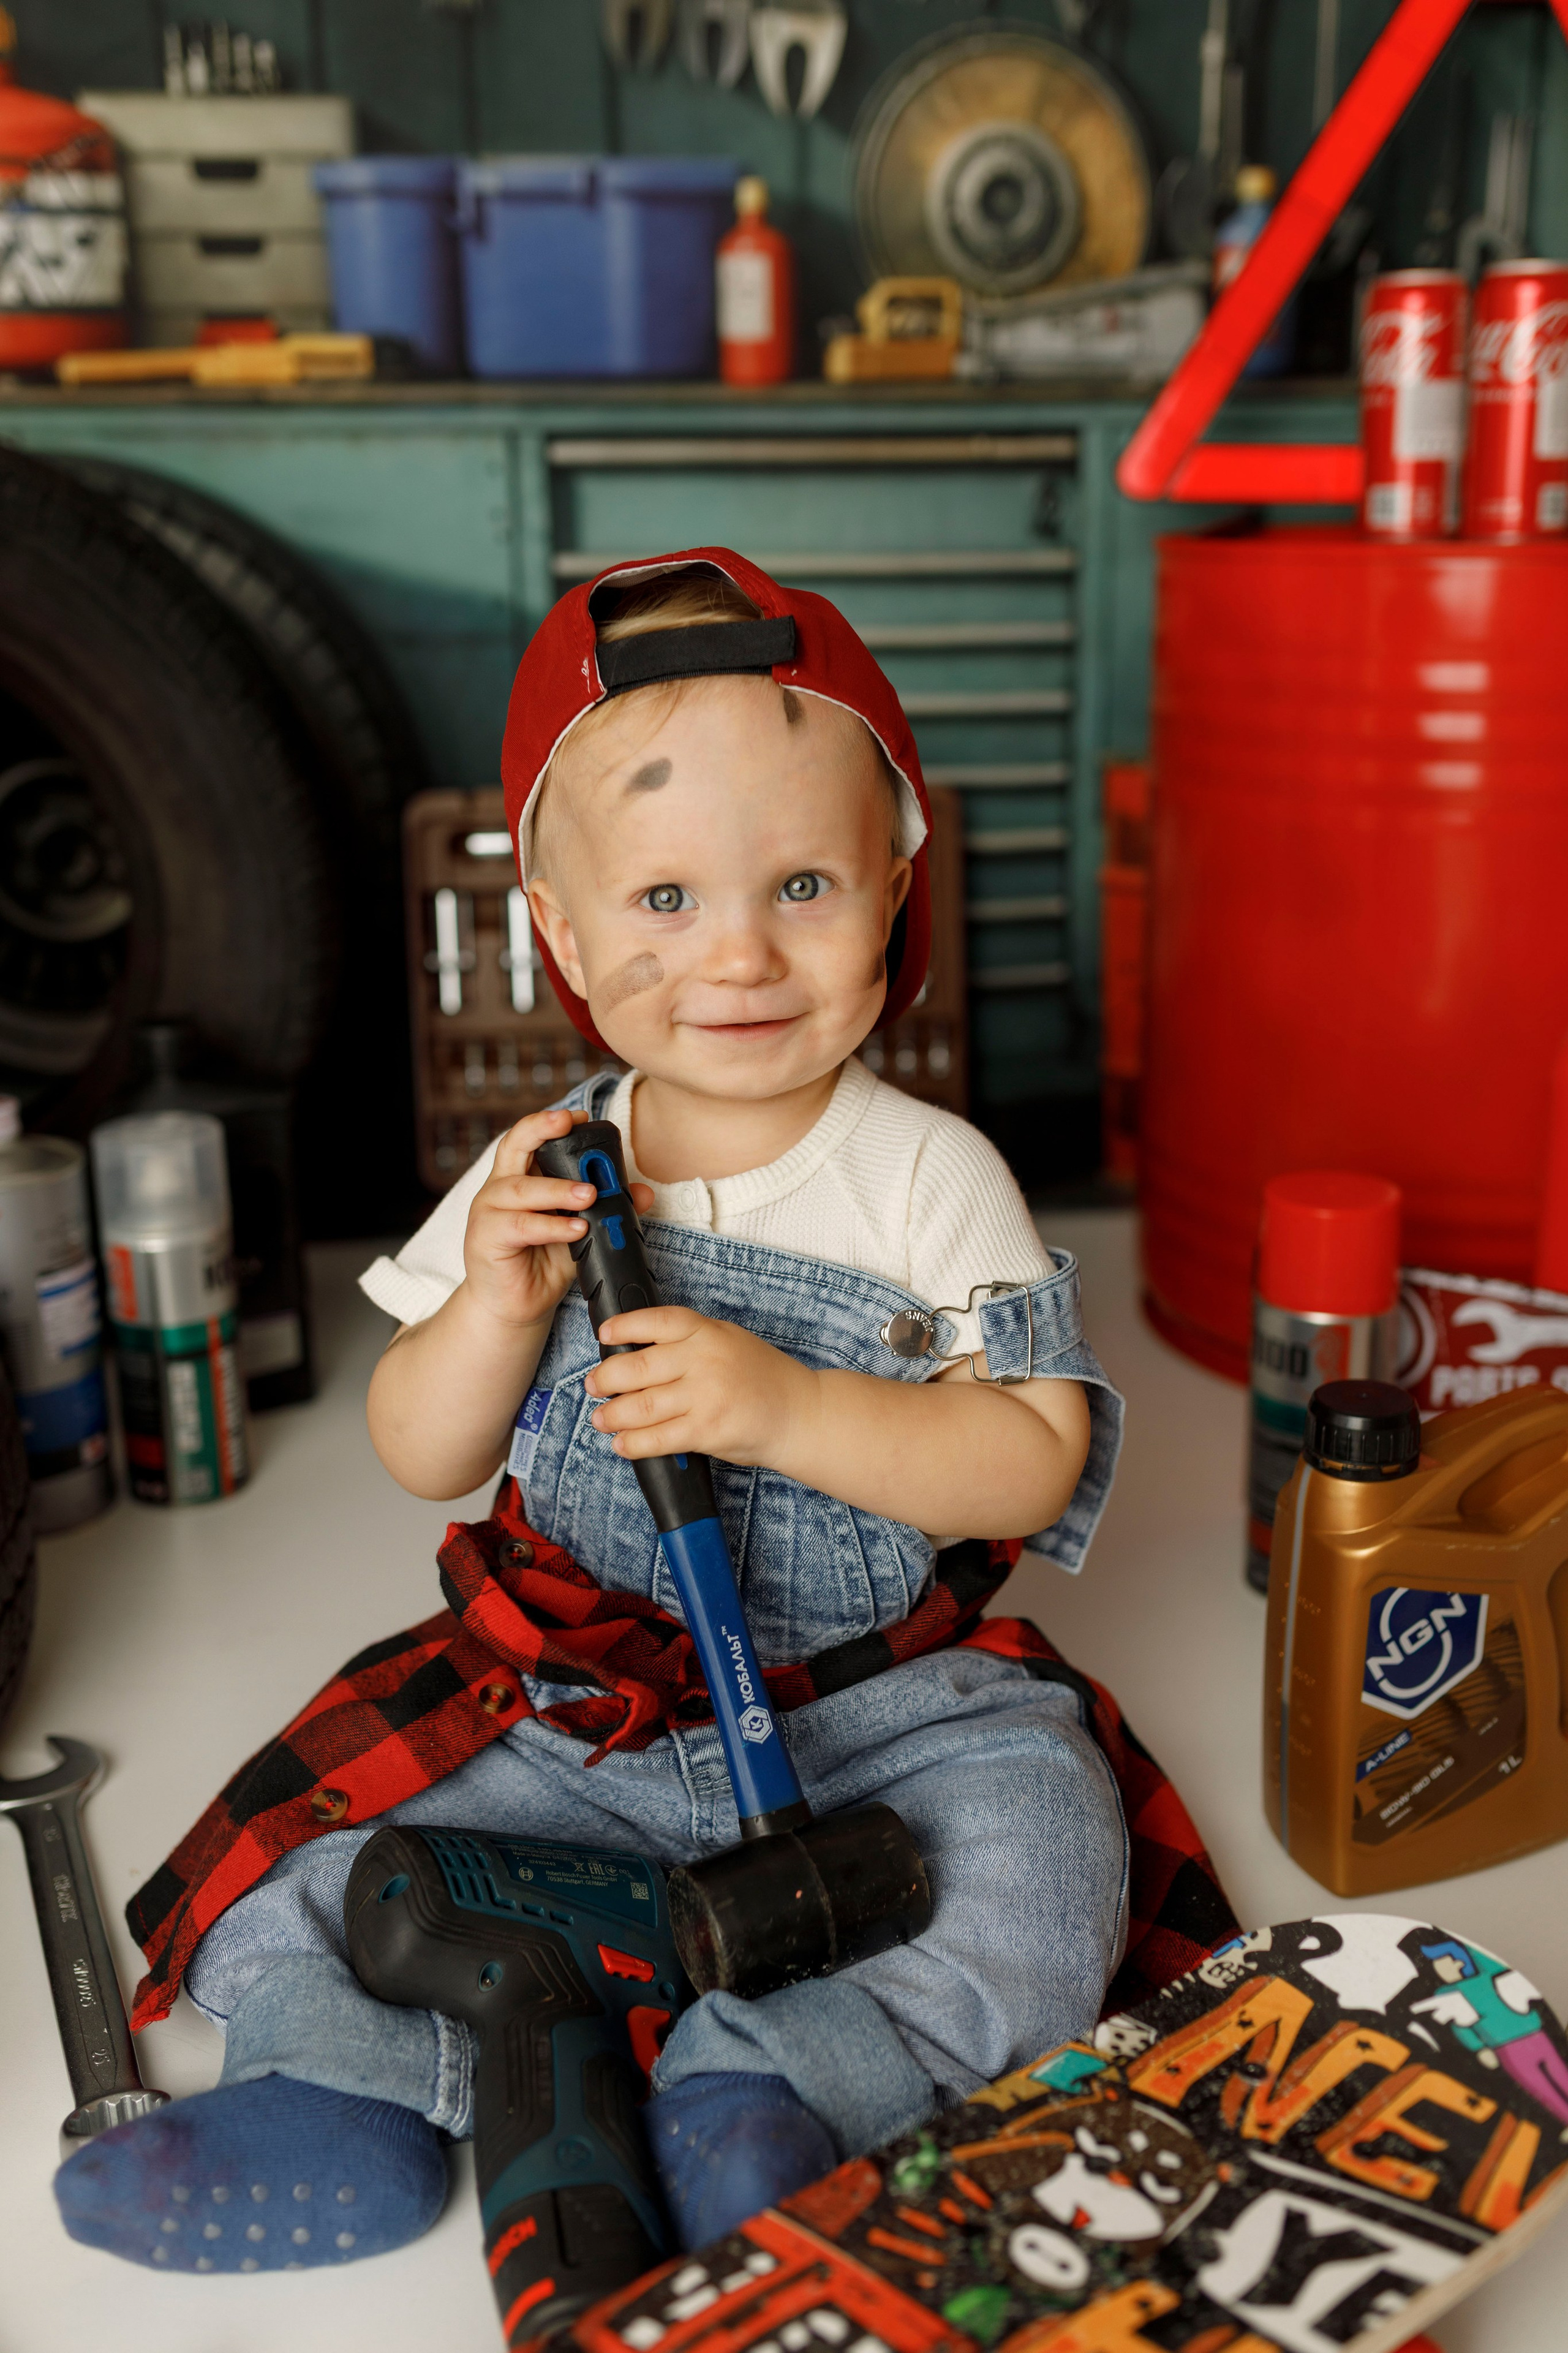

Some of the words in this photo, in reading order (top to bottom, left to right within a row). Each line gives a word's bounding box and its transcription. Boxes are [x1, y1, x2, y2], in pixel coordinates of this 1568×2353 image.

[905, 1310, 933, 1332] JEANS
[1366, 1593, 1467, 1681] NGN
[727, 1634, 756, 1704] КОБАЛЬТ
[1365, 1731, 1410, 1772] A-LINE
[92, 2048, 111, 2066] 25
